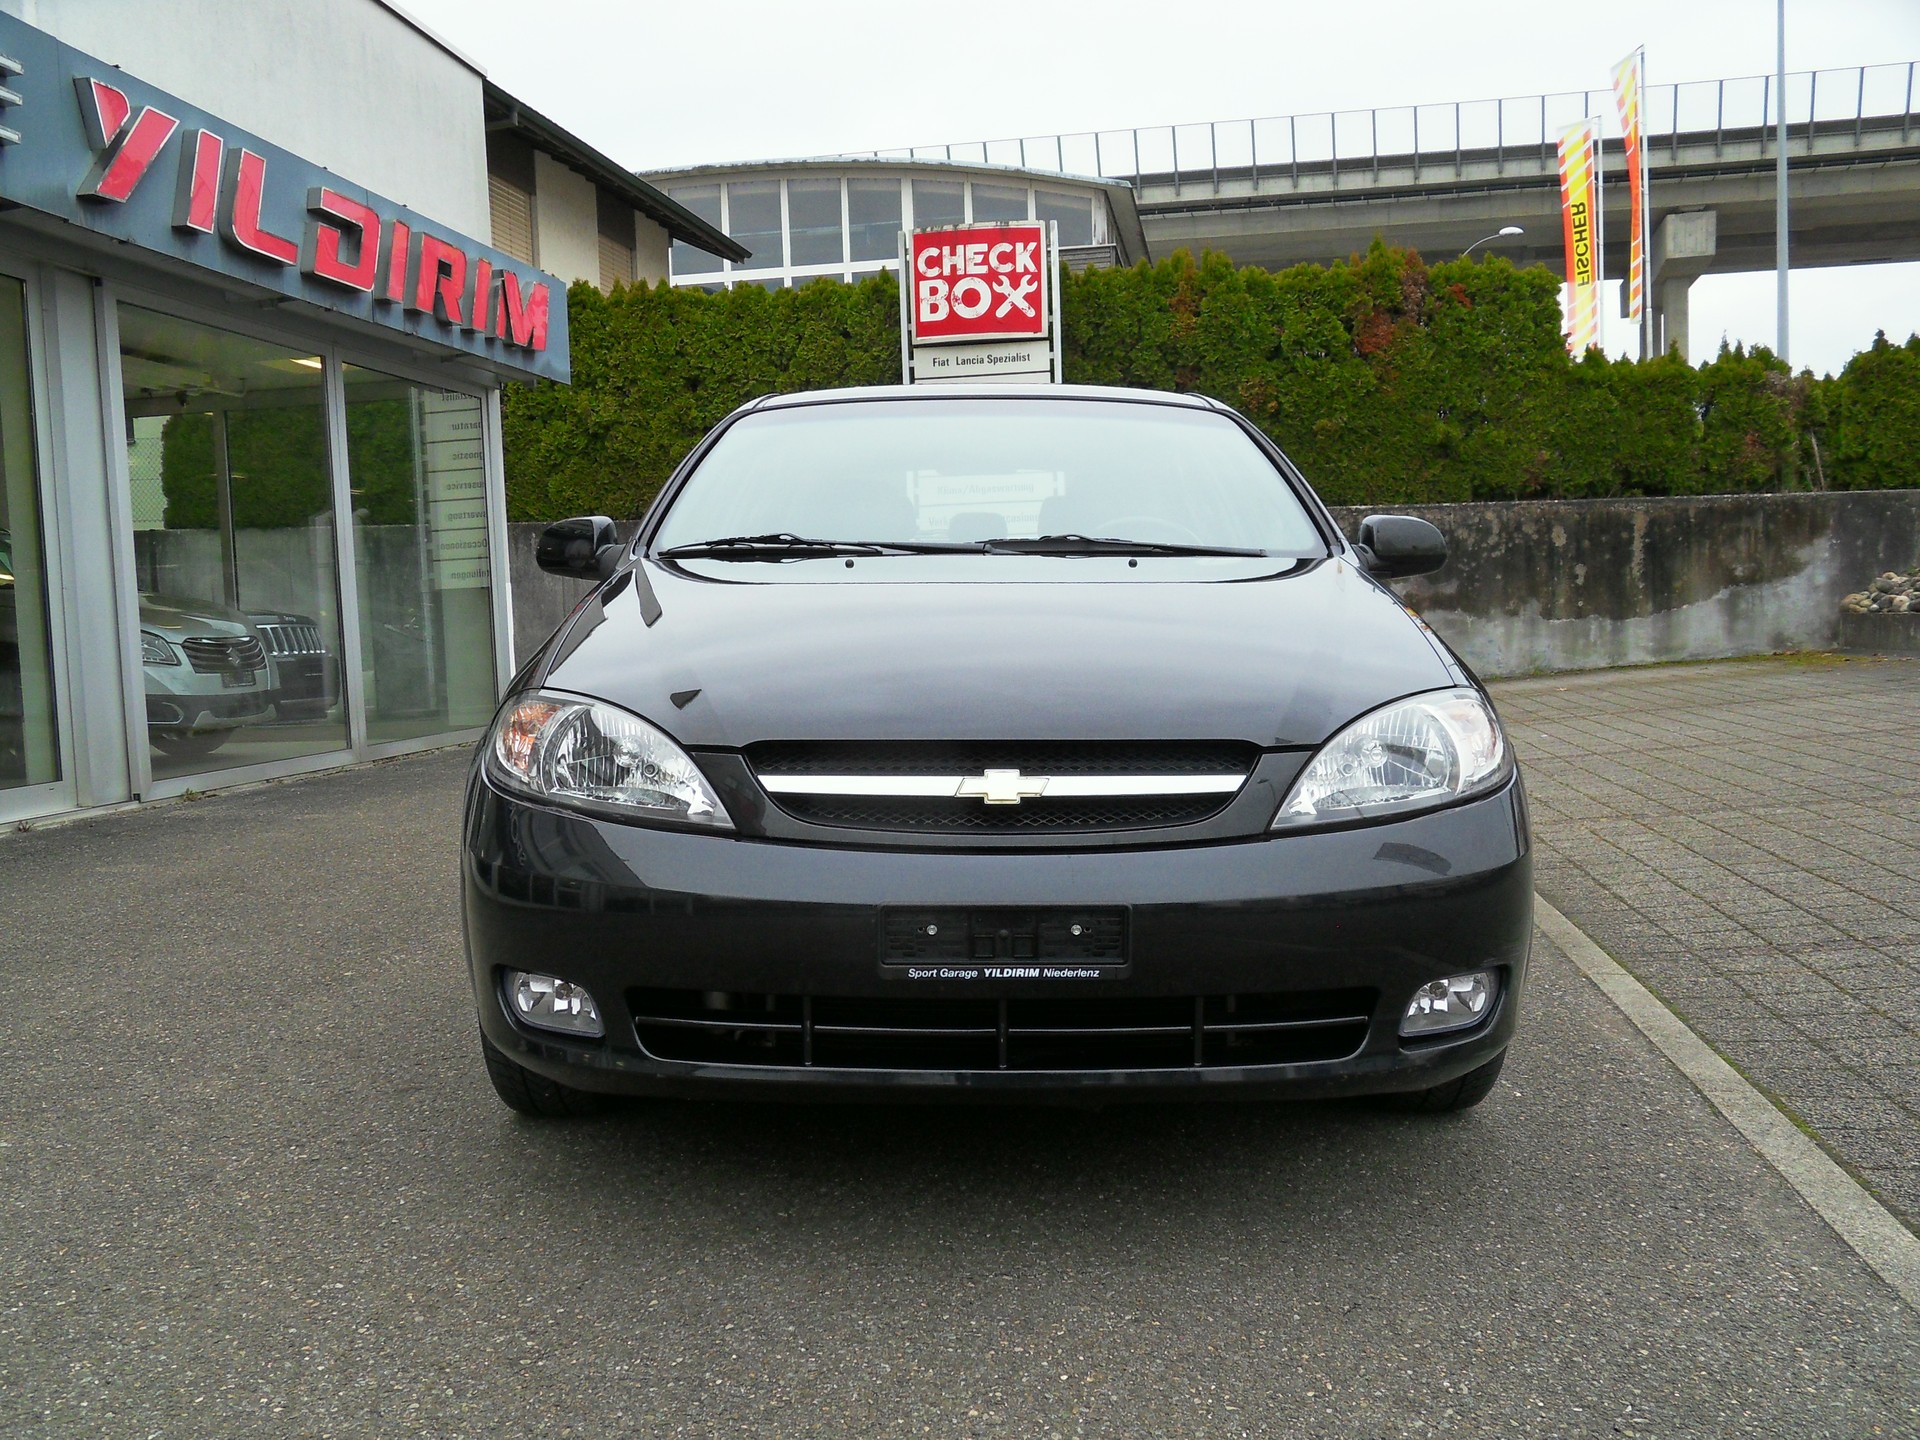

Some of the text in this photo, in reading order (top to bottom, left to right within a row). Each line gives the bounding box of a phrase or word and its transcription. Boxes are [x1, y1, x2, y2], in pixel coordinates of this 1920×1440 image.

[73, 75, 549, 352] YILDIRIM
[916, 241, 1038, 277] CHECK
[918, 274, 1038, 323] BOX
[932, 352, 1031, 367] Fiat Lancia Spezialist
[908, 968, 1100, 979] Sport Garage YILDIRIM Niederlenz
